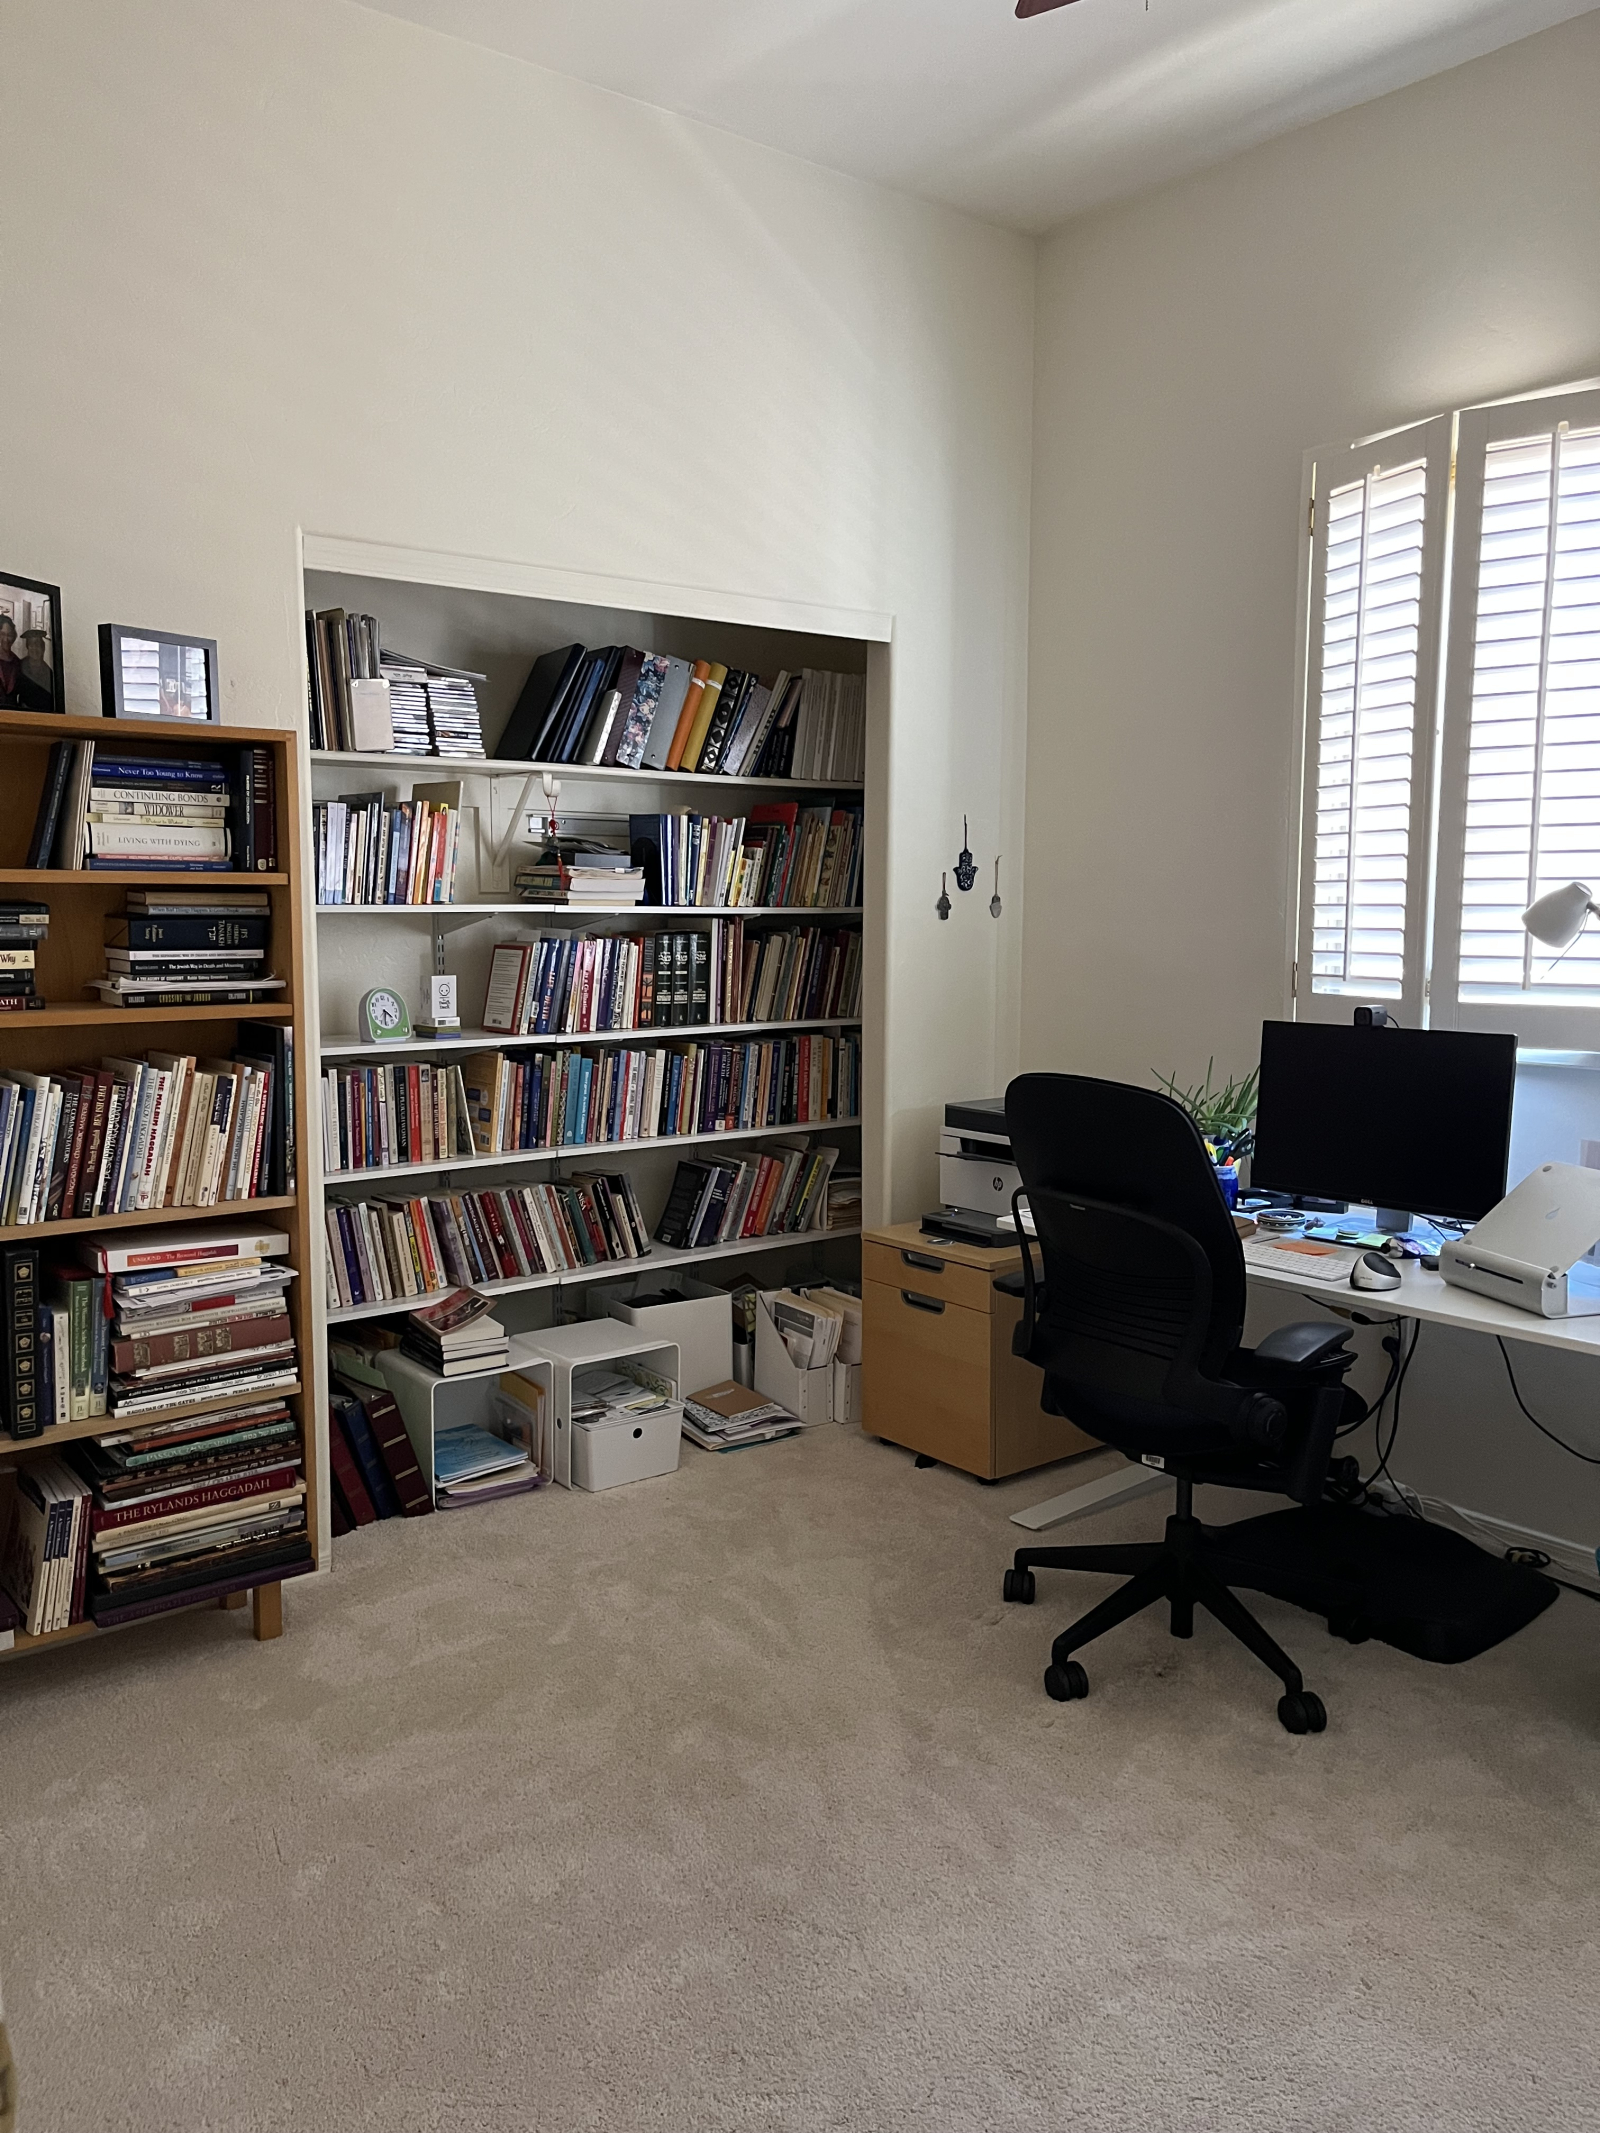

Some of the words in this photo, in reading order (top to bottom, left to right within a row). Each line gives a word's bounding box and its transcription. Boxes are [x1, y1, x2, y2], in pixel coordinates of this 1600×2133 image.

[118, 766, 139, 775] Never
[156, 770, 175, 778] Young
[114, 791, 175, 801] CONTINUING
[178, 793, 208, 803] BONDS
[144, 804, 184, 816] WIDOWER
[240, 929, 248, 938] JPS
[541, 995, 552, 1020] DEATH
[98, 1085, 106, 1101] CHAI
[147, 1077, 155, 1091] THE
[64, 1092, 72, 1114] SEDER
[96, 1101, 104, 1112] ISH
[143, 1092, 153, 1118] BRESLOV
[153, 1094, 163, 1126] MALBIM
[79, 1103, 88, 1129] MASTERS
[93, 1114, 102, 1126] BEN
[63, 1108, 77, 1163] COMMENTATORS
[136, 1120, 148, 1159] HAGGADAH
[233, 1134, 241, 1159] HOLISTIC
[237, 1100, 246, 1133] HAGGADAH
[144, 1128, 157, 1176] HAGGADAH
[253, 1153, 261, 1184] HAGGADAH
[994, 1177, 1002, 1191] hp
[577, 1192, 587, 1211] NISA
[465, 1195, 483, 1243] BIOMEDICALIZATION
[132, 1254, 161, 1263] UNBOUND
[126, 1405, 157, 1415] HAGGADAH
[114, 1507, 141, 1522] THE
[143, 1496, 199, 1516] RYLANDS
[201, 1479, 270, 1501] HAGGADAH
